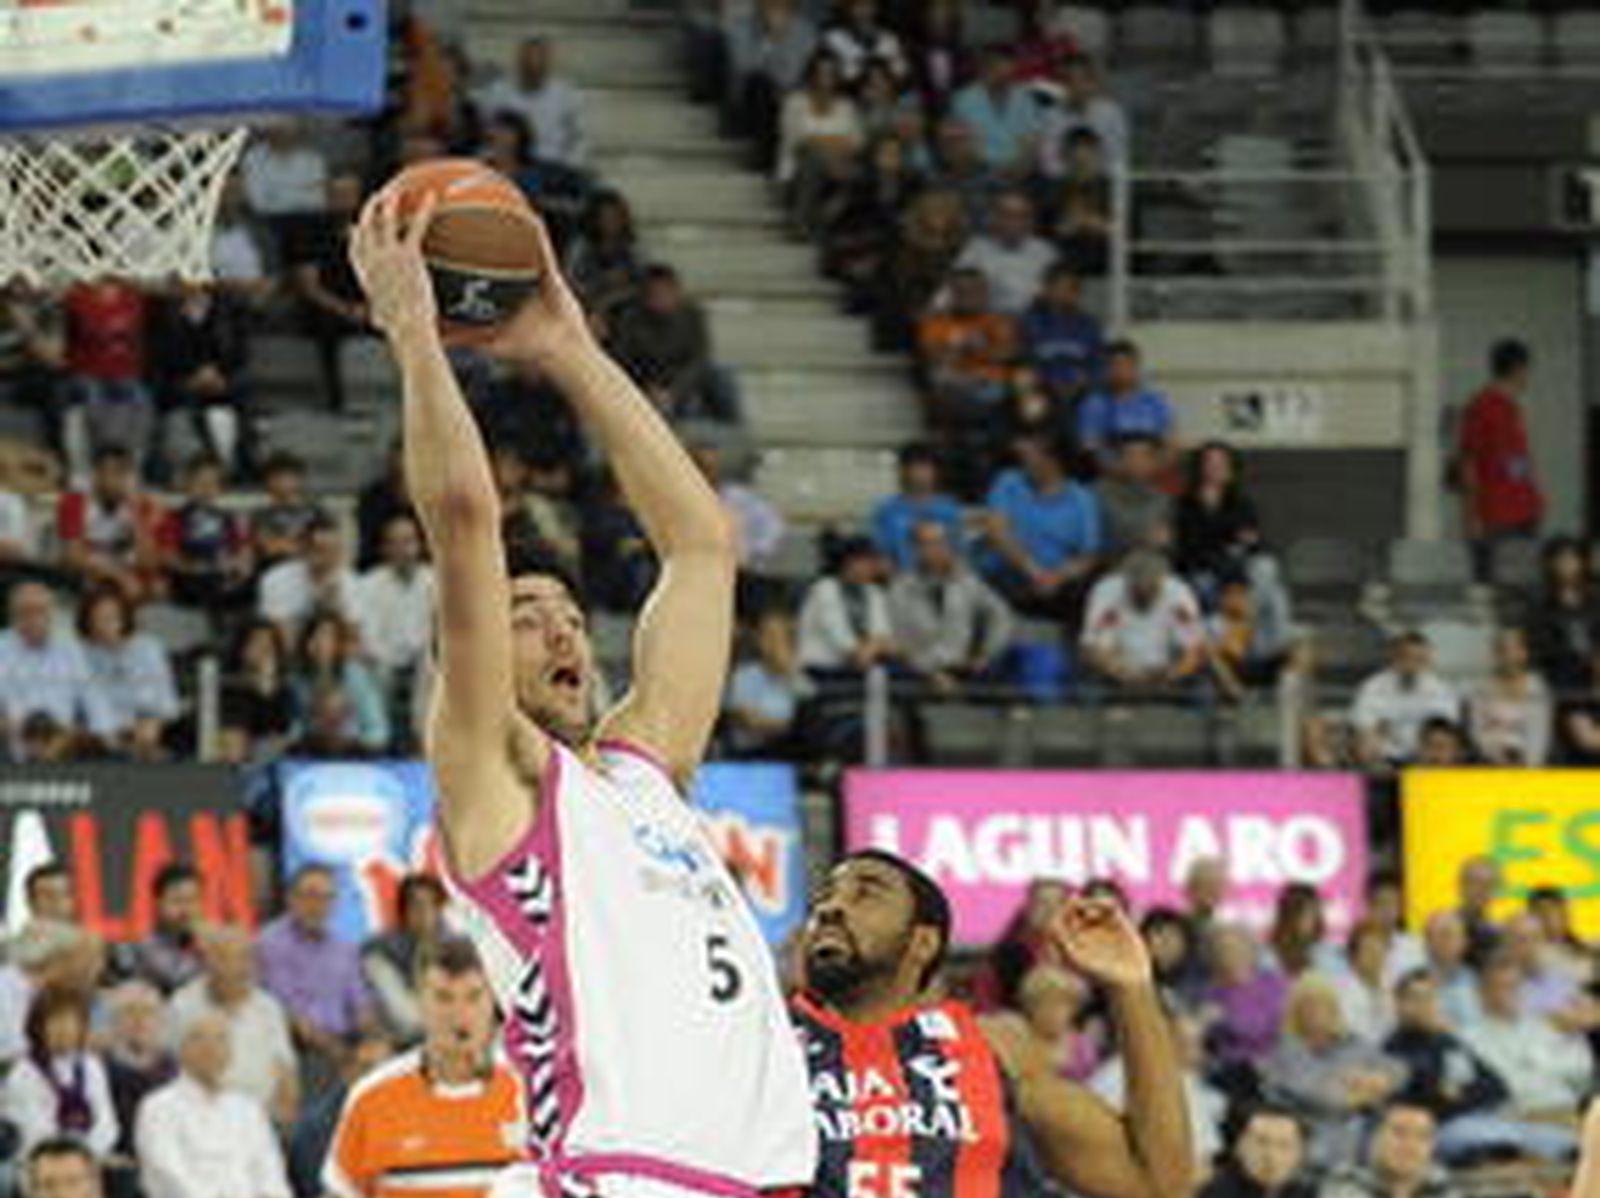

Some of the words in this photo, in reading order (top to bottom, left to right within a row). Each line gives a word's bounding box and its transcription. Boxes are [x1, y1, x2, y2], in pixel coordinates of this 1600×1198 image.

[1169, 811, 1344, 885] ARO
[706, 934, 742, 1004] 5
[809, 1068, 894, 1104] AJA
[811, 1101, 979, 1143] ABORAL
